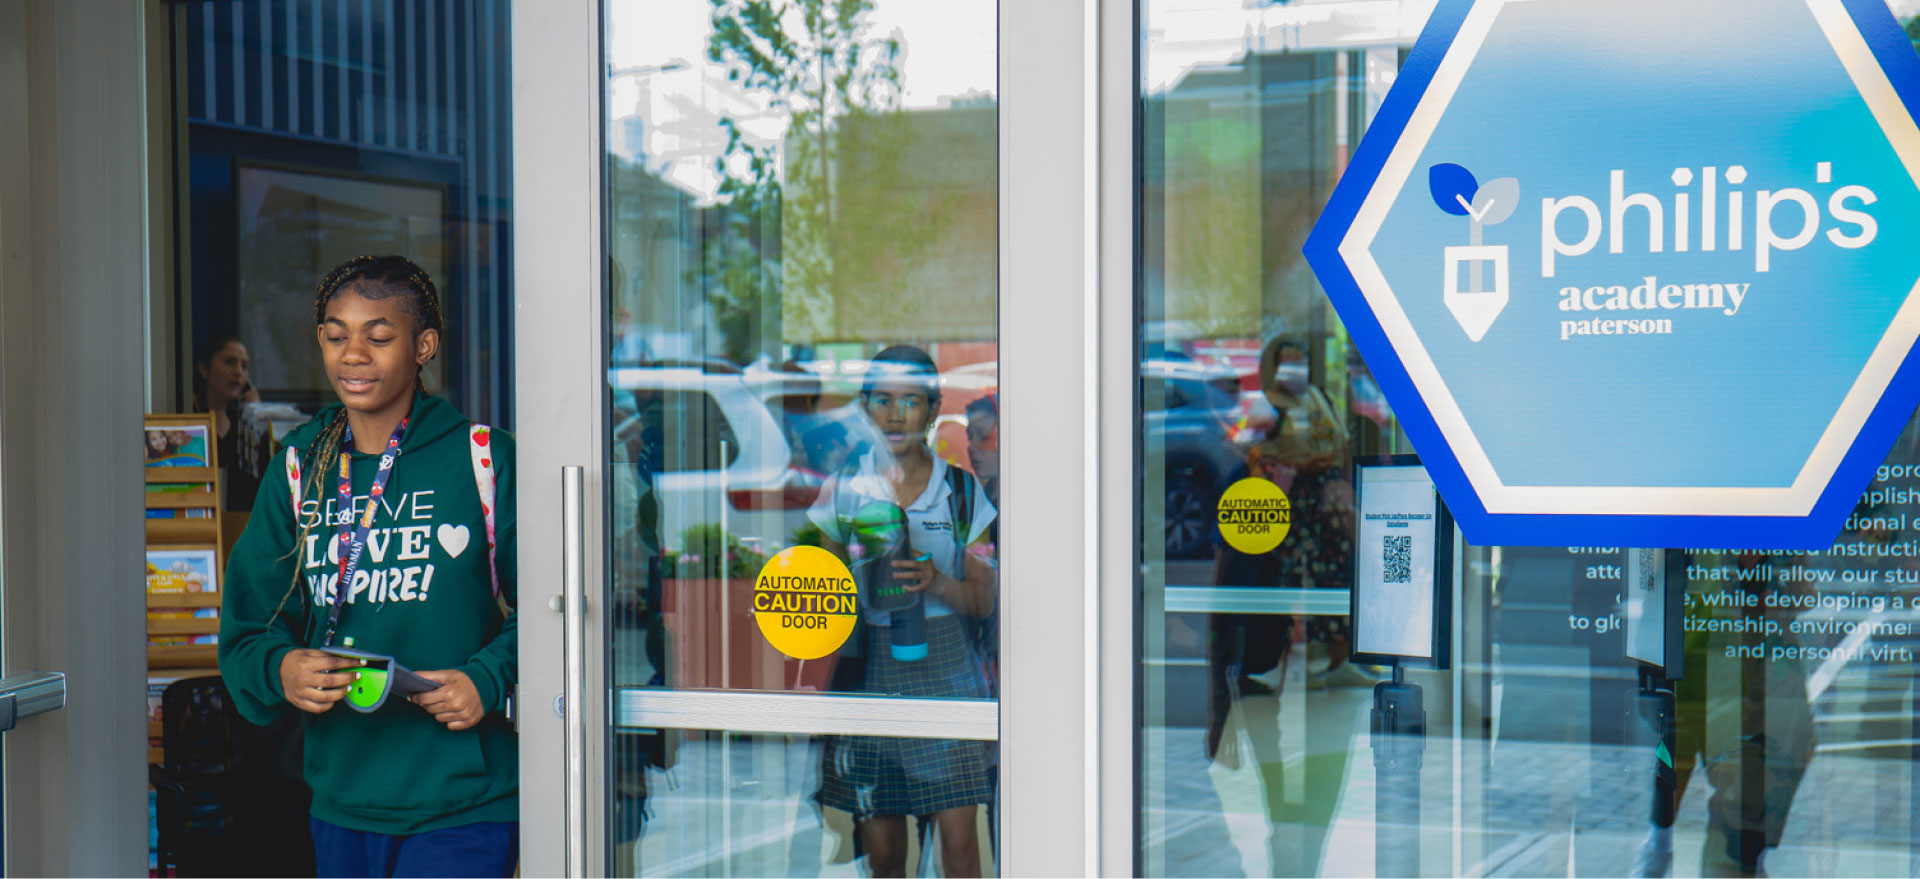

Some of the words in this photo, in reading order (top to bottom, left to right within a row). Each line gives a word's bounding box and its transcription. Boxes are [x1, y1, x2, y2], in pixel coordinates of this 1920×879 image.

[1541, 161, 1879, 278] philip's
[1558, 276, 1751, 316] academy
[1560, 317, 1672, 340] paterson
[1876, 463, 1920, 482] gor
[1222, 499, 1287, 509] AUTOMATIC
[1218, 510, 1290, 523] CAUTION
[1845, 512, 1906, 531] tional
[1238, 525, 1270, 534] DOOR
[1827, 539, 1920, 557] instructi
[1686, 564, 1730, 581] that
[1736, 564, 1772, 582] will
[1779, 564, 1836, 583] allow
[1842, 568, 1879, 583] our
[1884, 566, 1920, 583] stu
[759, 576, 852, 592] AUTOMATIC
[754, 592, 857, 613] CAUTION
[1701, 590, 1758, 607] while
[1764, 591, 1885, 613] developing
[1892, 596, 1904, 609] a
[782, 615, 827, 629] DOOR
[1568, 613, 1590, 630] to
[1684, 614, 1783, 636] tizenship,
[1789, 617, 1912, 635] environme
[1725, 642, 1765, 658] and
[1772, 642, 1865, 662] personal
[1871, 644, 1913, 661] virt
